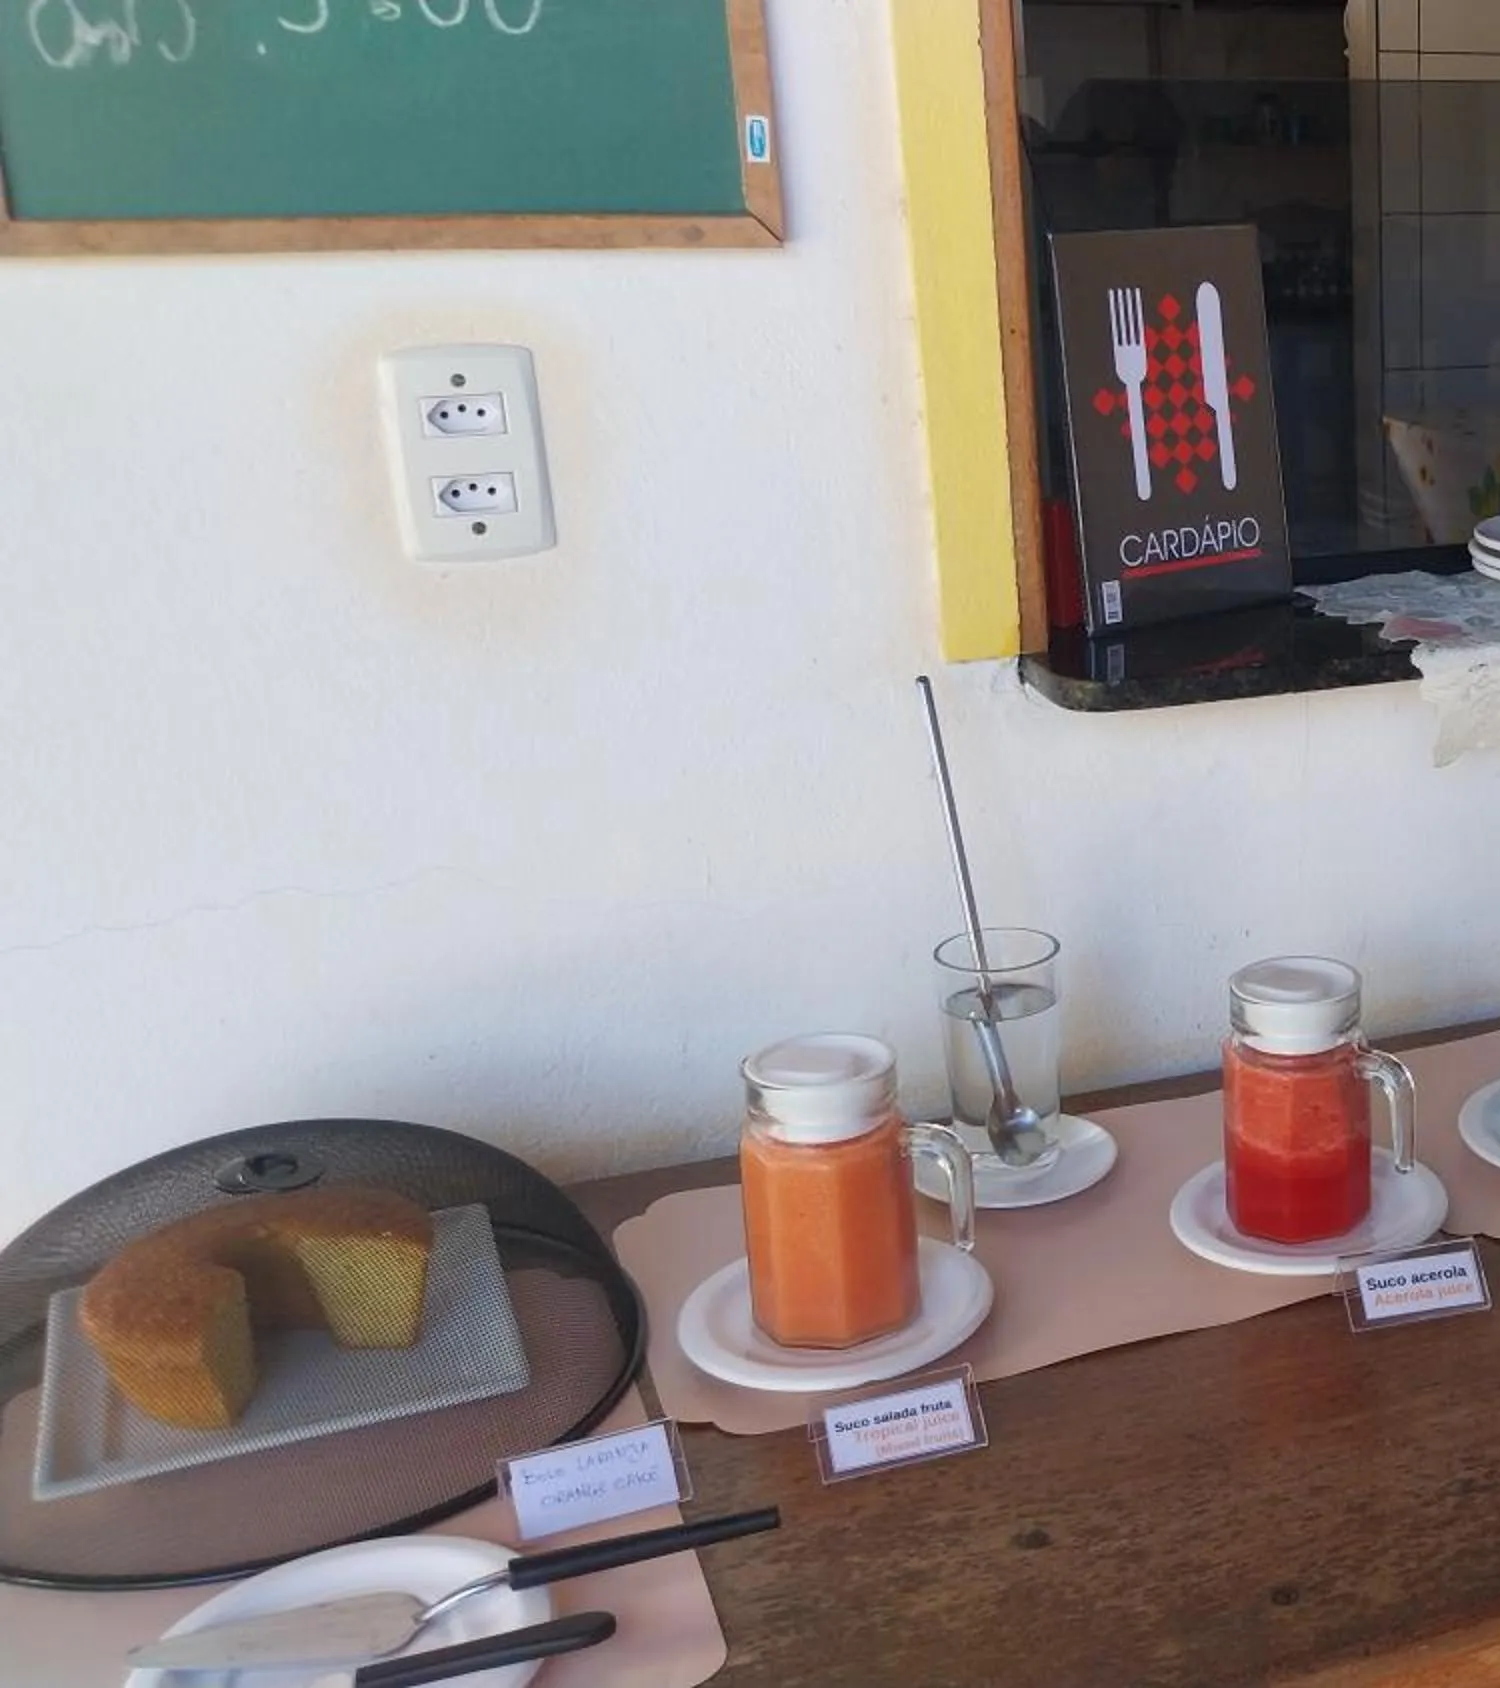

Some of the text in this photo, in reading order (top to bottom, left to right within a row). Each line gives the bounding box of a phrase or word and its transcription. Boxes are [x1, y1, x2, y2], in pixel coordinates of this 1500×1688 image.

[1119, 514, 1261, 568] CARDÁPIO
[1366, 1265, 1468, 1291] Suco acerola
[1375, 1286, 1434, 1307] Acerola
[834, 1399, 953, 1433] Suco salada fruta
[853, 1419, 918, 1443] Tropical
